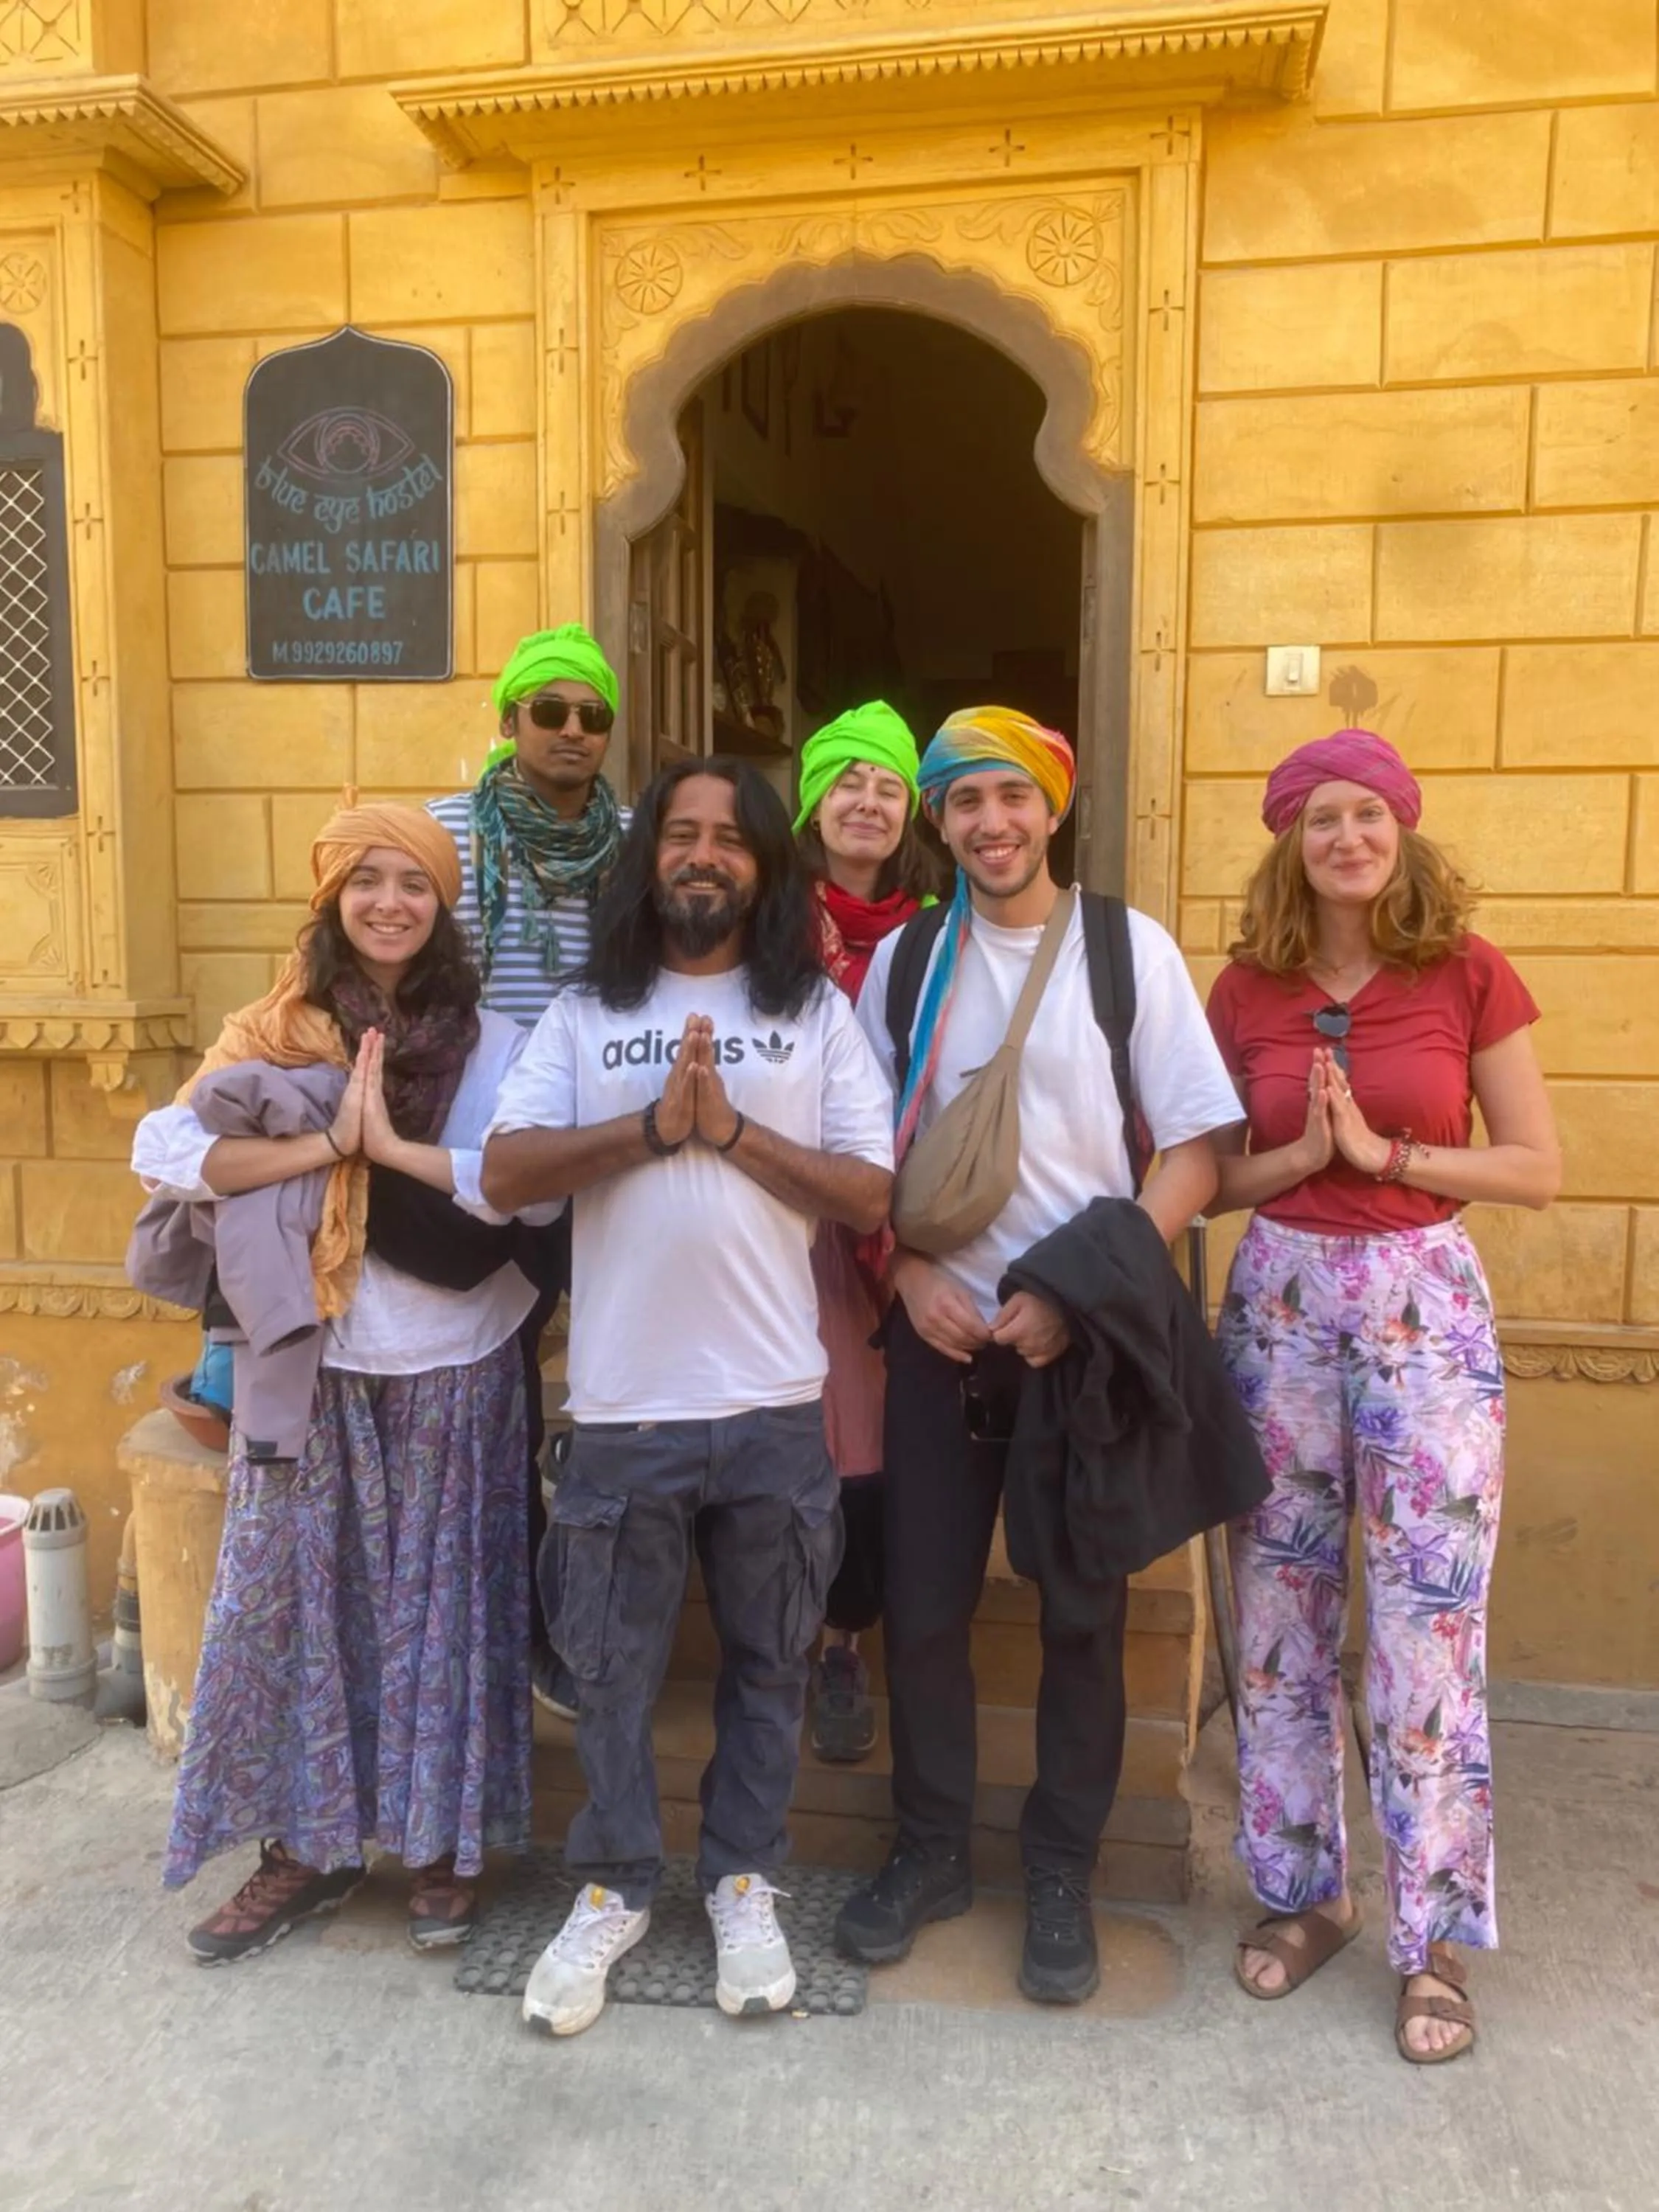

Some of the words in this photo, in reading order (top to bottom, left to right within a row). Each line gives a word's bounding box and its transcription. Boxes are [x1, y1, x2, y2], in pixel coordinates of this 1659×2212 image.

[254, 454, 309, 514] blue
[313, 493, 361, 534] eye
[366, 453, 444, 520] hostel
[251, 540, 331, 575] CAMEL
[345, 539, 440, 574] SAFARI
[302, 586, 386, 620] CAFE
[602, 1029, 745, 1070] adis
